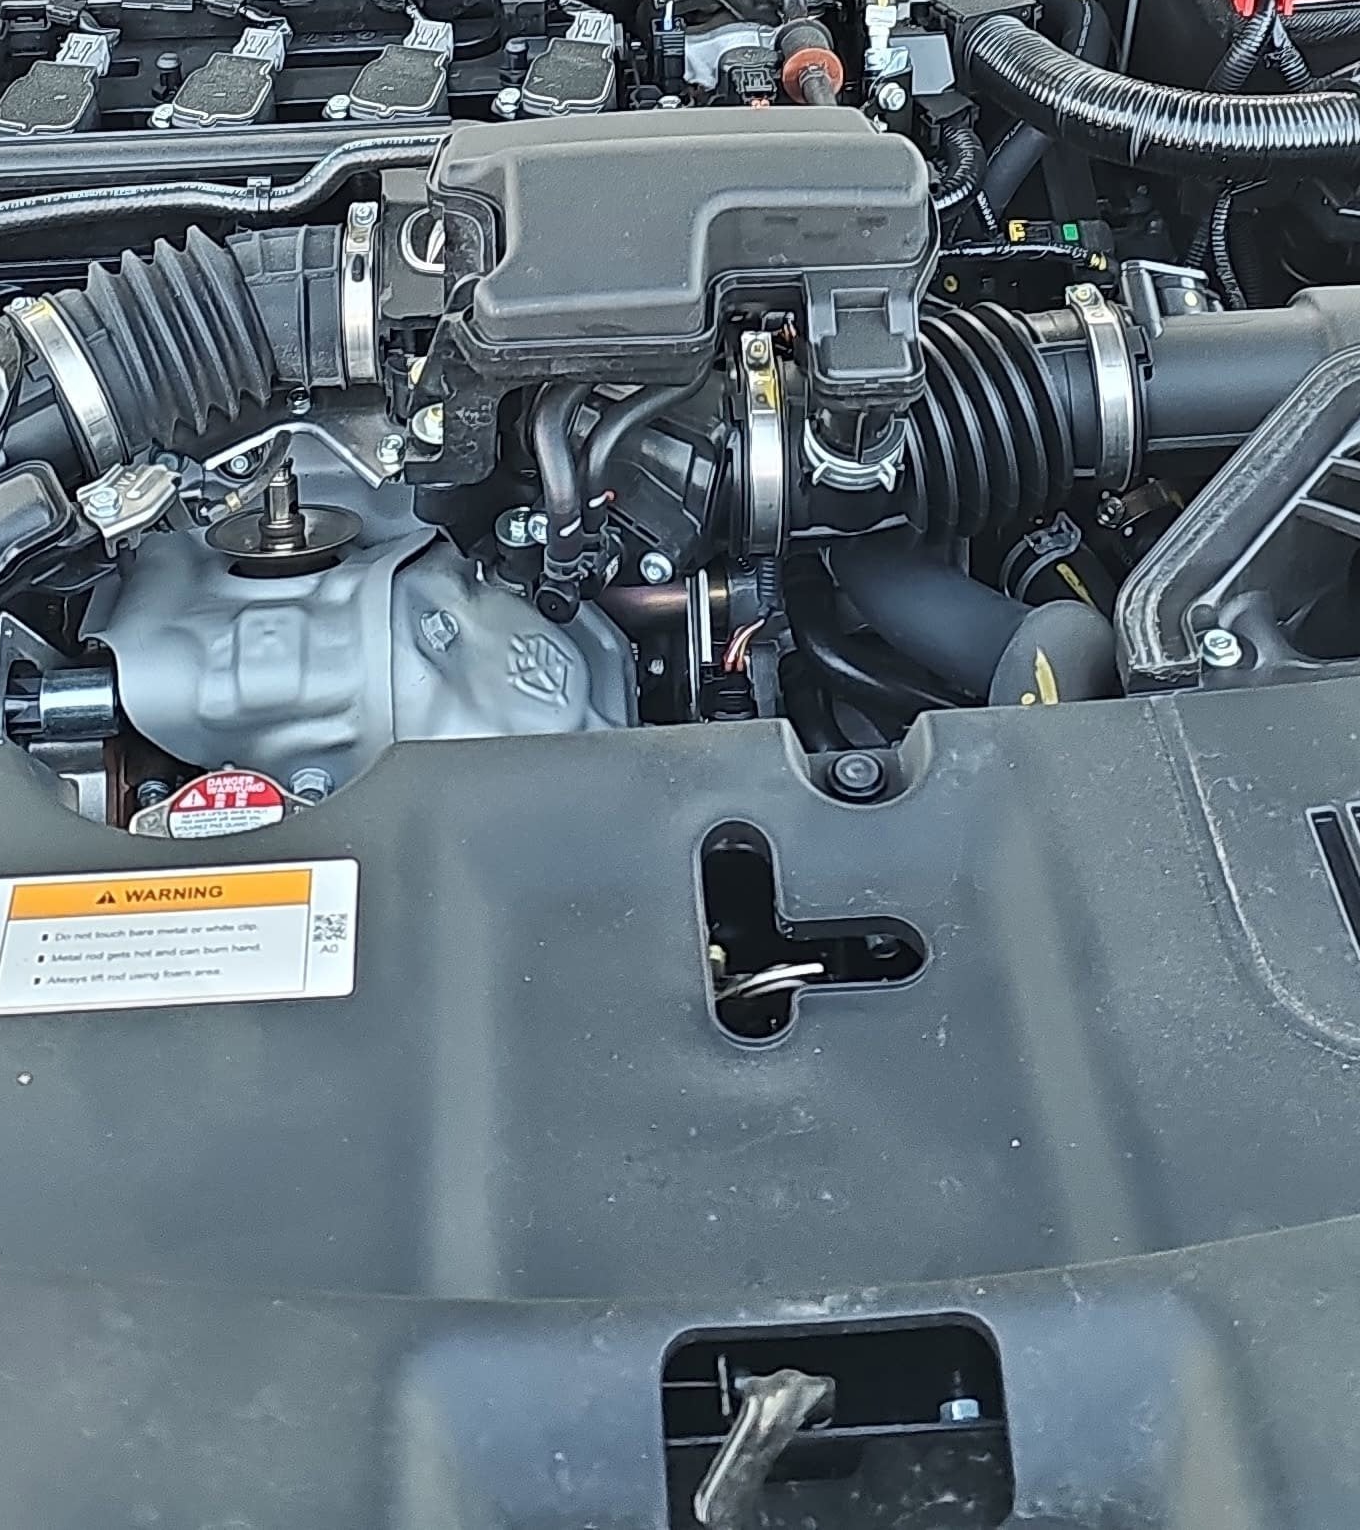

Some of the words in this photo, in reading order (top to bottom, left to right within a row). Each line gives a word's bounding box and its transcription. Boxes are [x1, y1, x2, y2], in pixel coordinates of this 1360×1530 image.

[125, 886, 224, 903] WARNING
[55, 932, 71, 941] Do
[95, 930, 126, 939] touch
[129, 929, 154, 937] bare
[157, 927, 187, 935] metal
[206, 924, 234, 932] white
[52, 952, 82, 961] Metal
[85, 951, 105, 960] rod
[107, 951, 131, 961] gets
[134, 949, 152, 958] hot
[155, 948, 176, 957] and
[180, 948, 200, 956] can
[203, 945, 229, 954] burn
[47, 975, 88, 984] Always
[91, 973, 103, 982] lift
[107, 972, 126, 981] rod
[129, 971, 159, 981] using
[163, 969, 191, 978] foam
